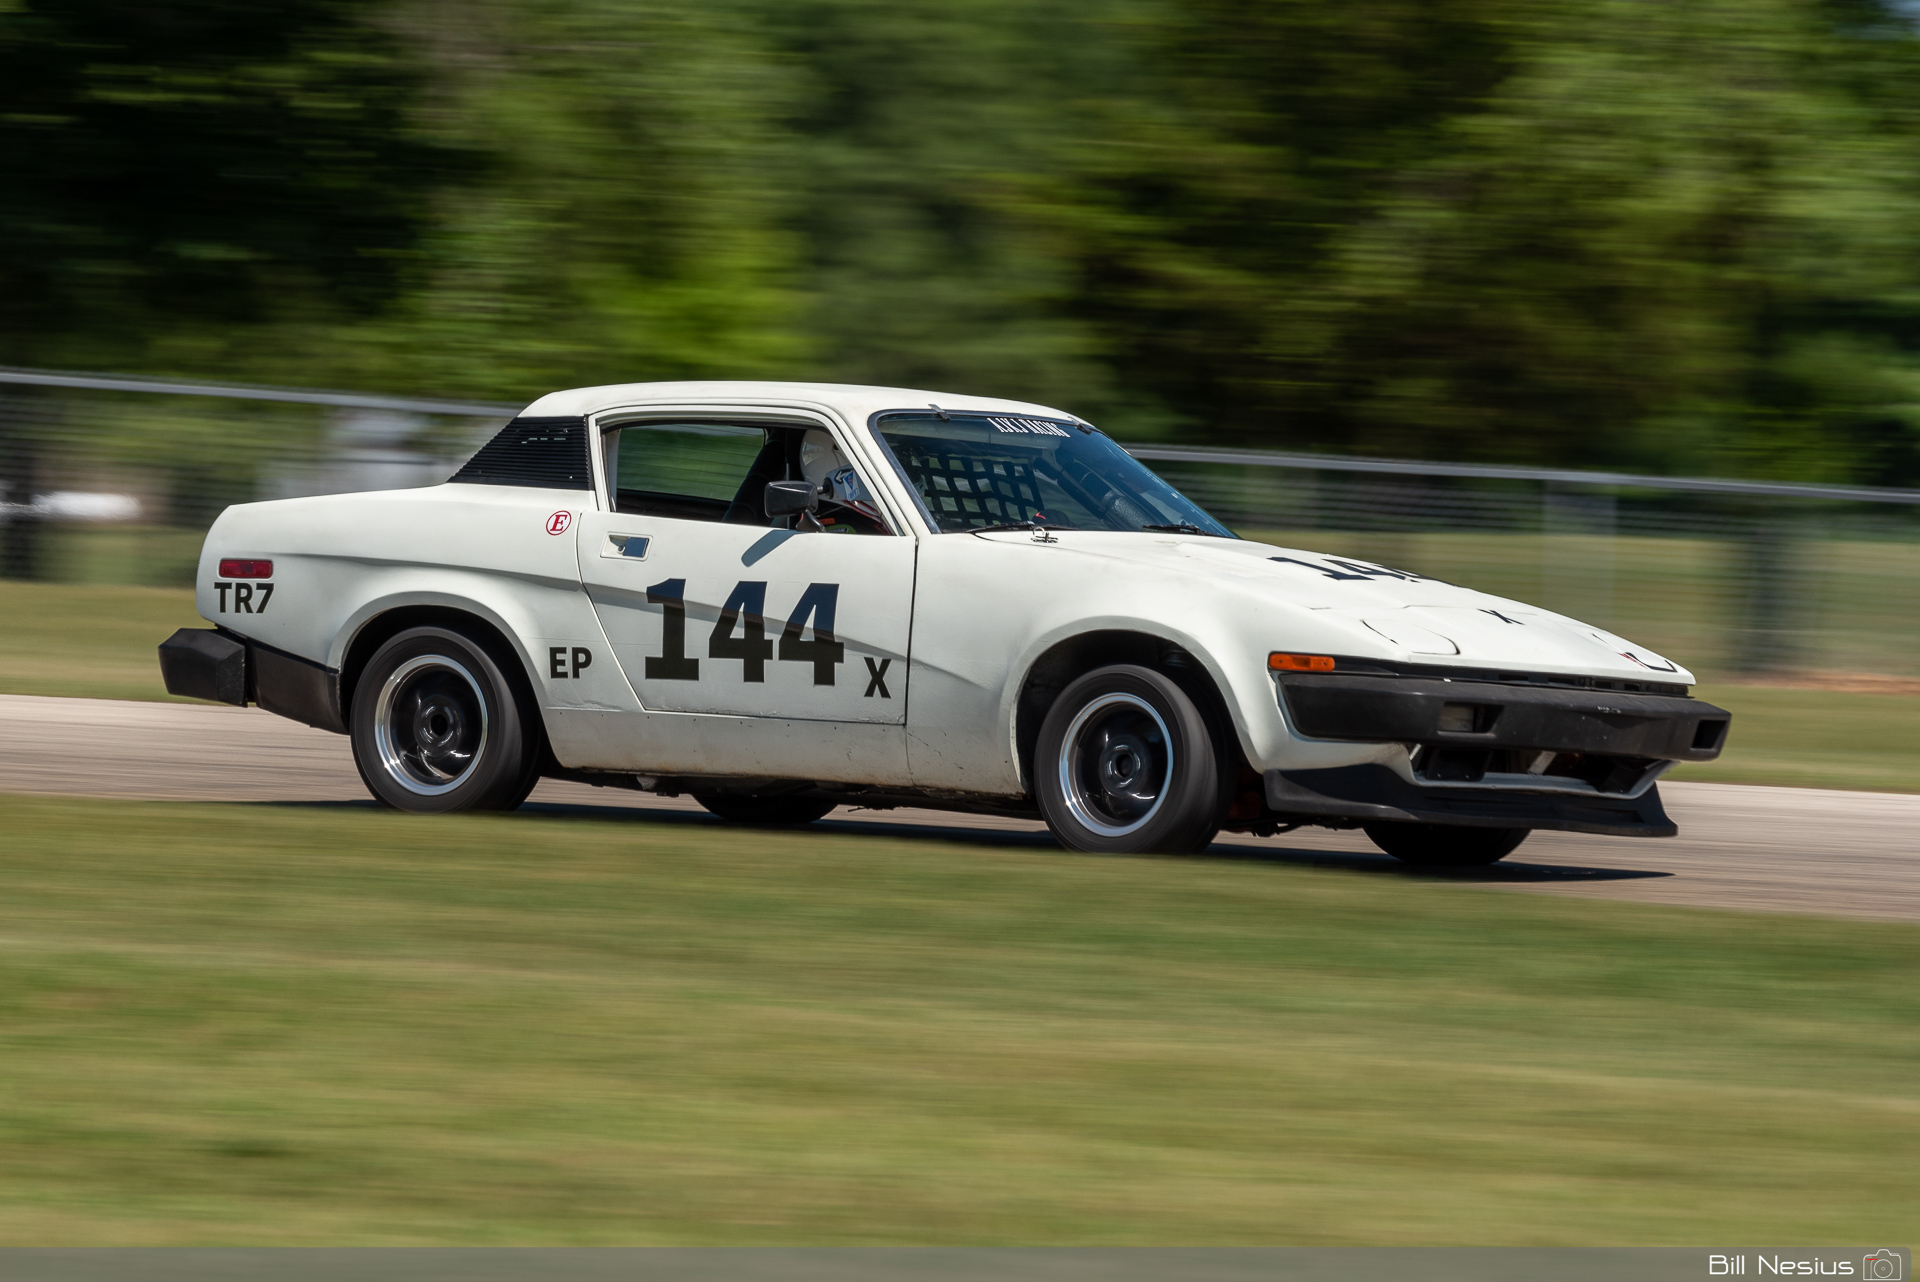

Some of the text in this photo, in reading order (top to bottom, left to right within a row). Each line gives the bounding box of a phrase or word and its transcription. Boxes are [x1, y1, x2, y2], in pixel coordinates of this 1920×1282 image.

[1018, 418, 1071, 438] RACING
[550, 514, 568, 531] E
[214, 582, 275, 614] TR7
[645, 578, 845, 686] 144
[1476, 608, 1526, 626] X
[549, 646, 593, 679] EP
[863, 657, 892, 699] X
